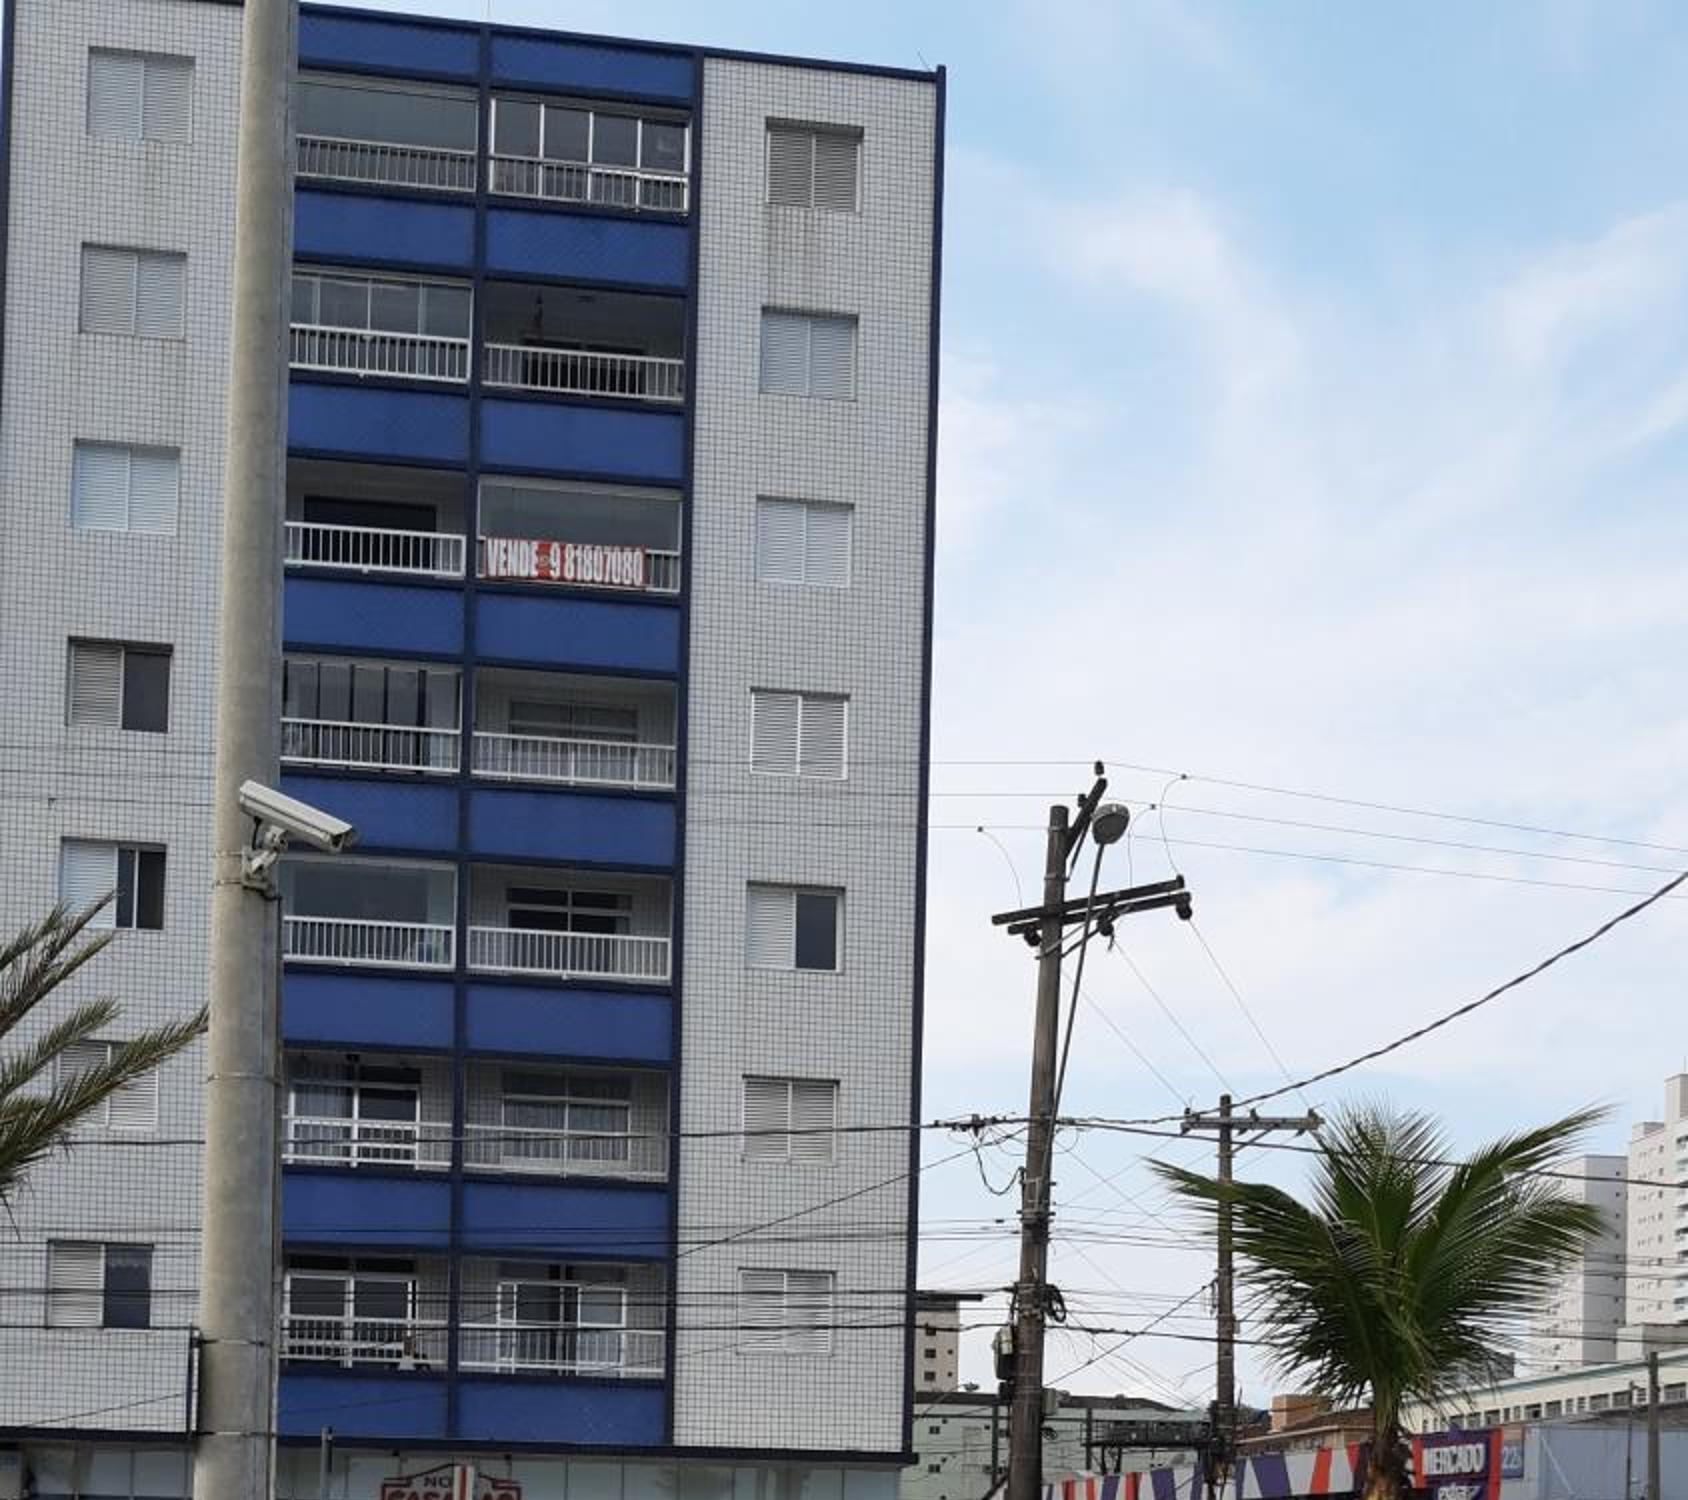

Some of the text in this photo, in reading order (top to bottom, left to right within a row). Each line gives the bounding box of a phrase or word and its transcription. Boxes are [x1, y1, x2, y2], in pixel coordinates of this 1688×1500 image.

[487, 537, 644, 587] VENDE 9 81807080
[1422, 1443, 1486, 1475] MERCADO
